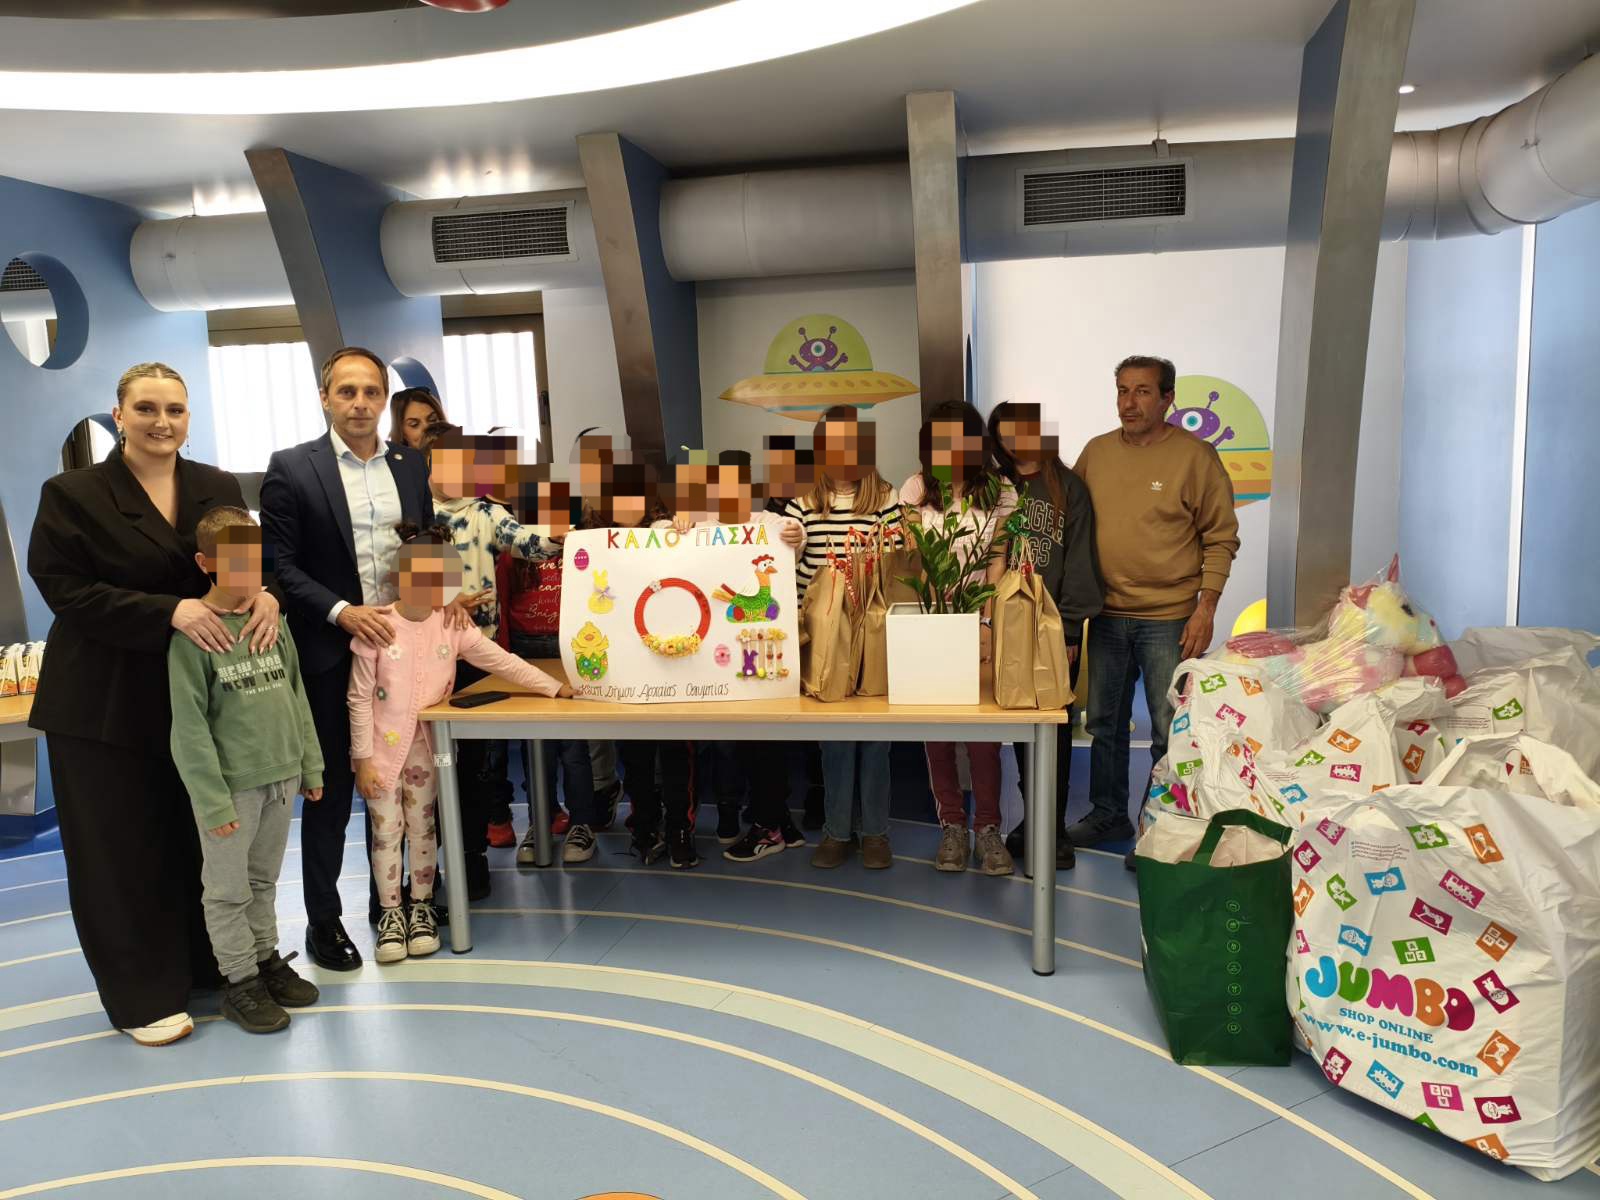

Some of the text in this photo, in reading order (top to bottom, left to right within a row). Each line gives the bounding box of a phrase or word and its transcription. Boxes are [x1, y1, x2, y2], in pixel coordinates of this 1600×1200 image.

[607, 524, 769, 549] ΚΑΛΟ ΠΑΣΧΑ
[1305, 956, 1475, 1031] JUMBO
[1303, 1012, 1478, 1077] www.e-jumbo.com
[1339, 1007, 1434, 1043] SHOP ONLINE
